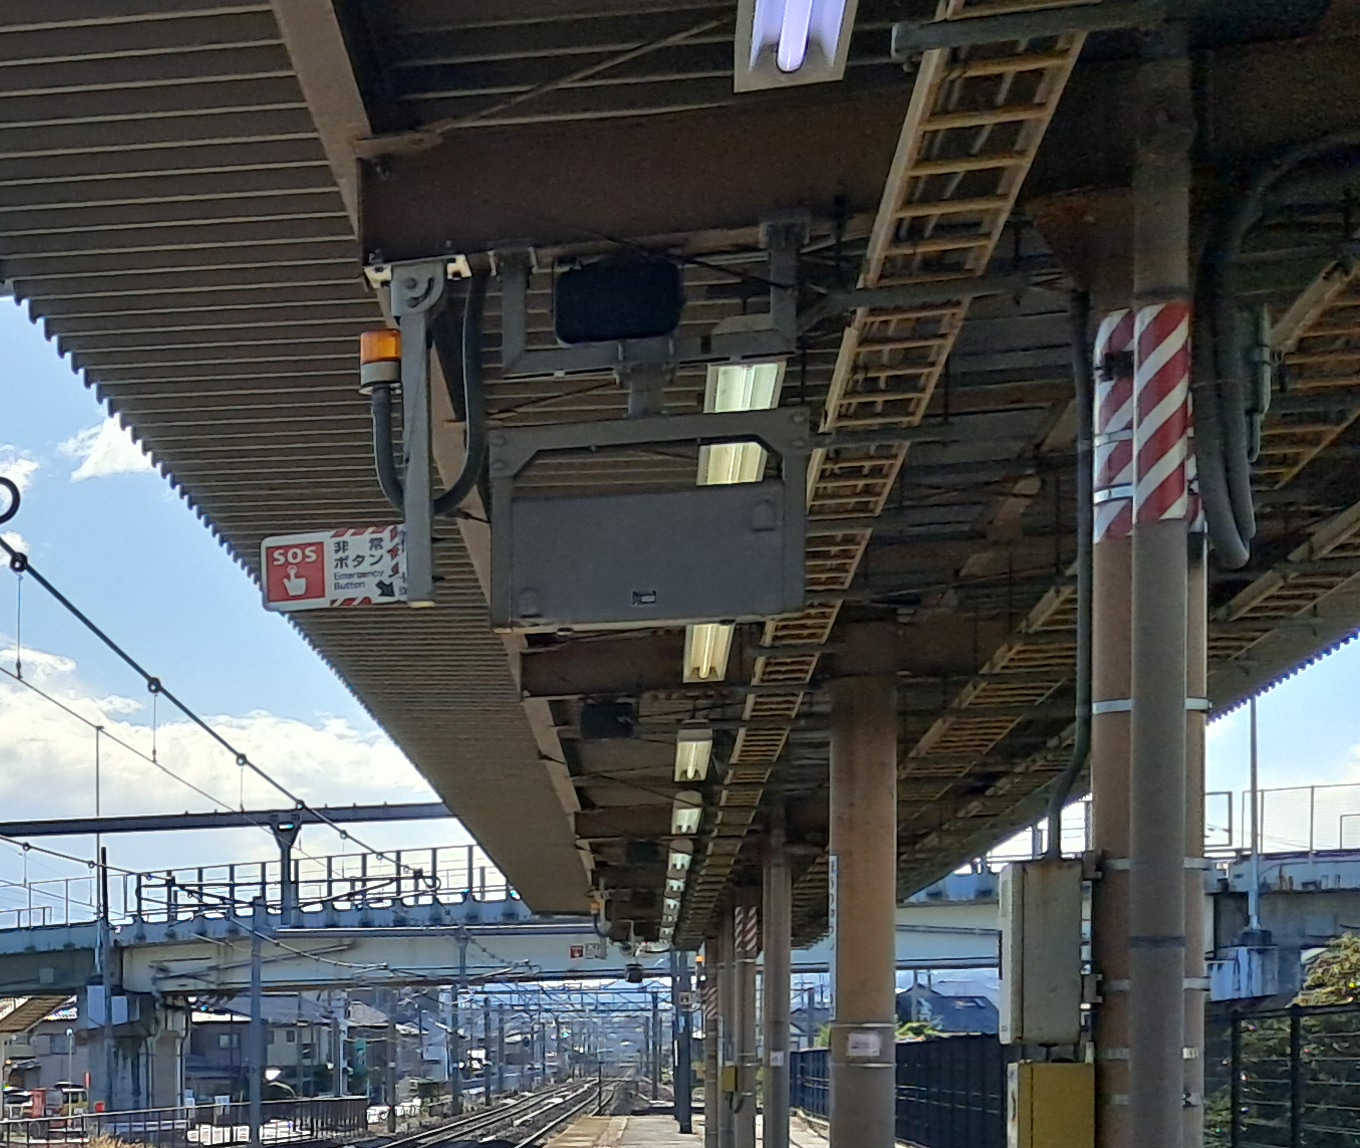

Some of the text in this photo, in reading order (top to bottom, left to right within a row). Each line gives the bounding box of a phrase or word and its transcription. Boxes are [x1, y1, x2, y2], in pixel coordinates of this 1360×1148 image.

[273, 546, 317, 565] SOS
[334, 553, 384, 569] ボタン
[334, 580, 366, 591] Button
